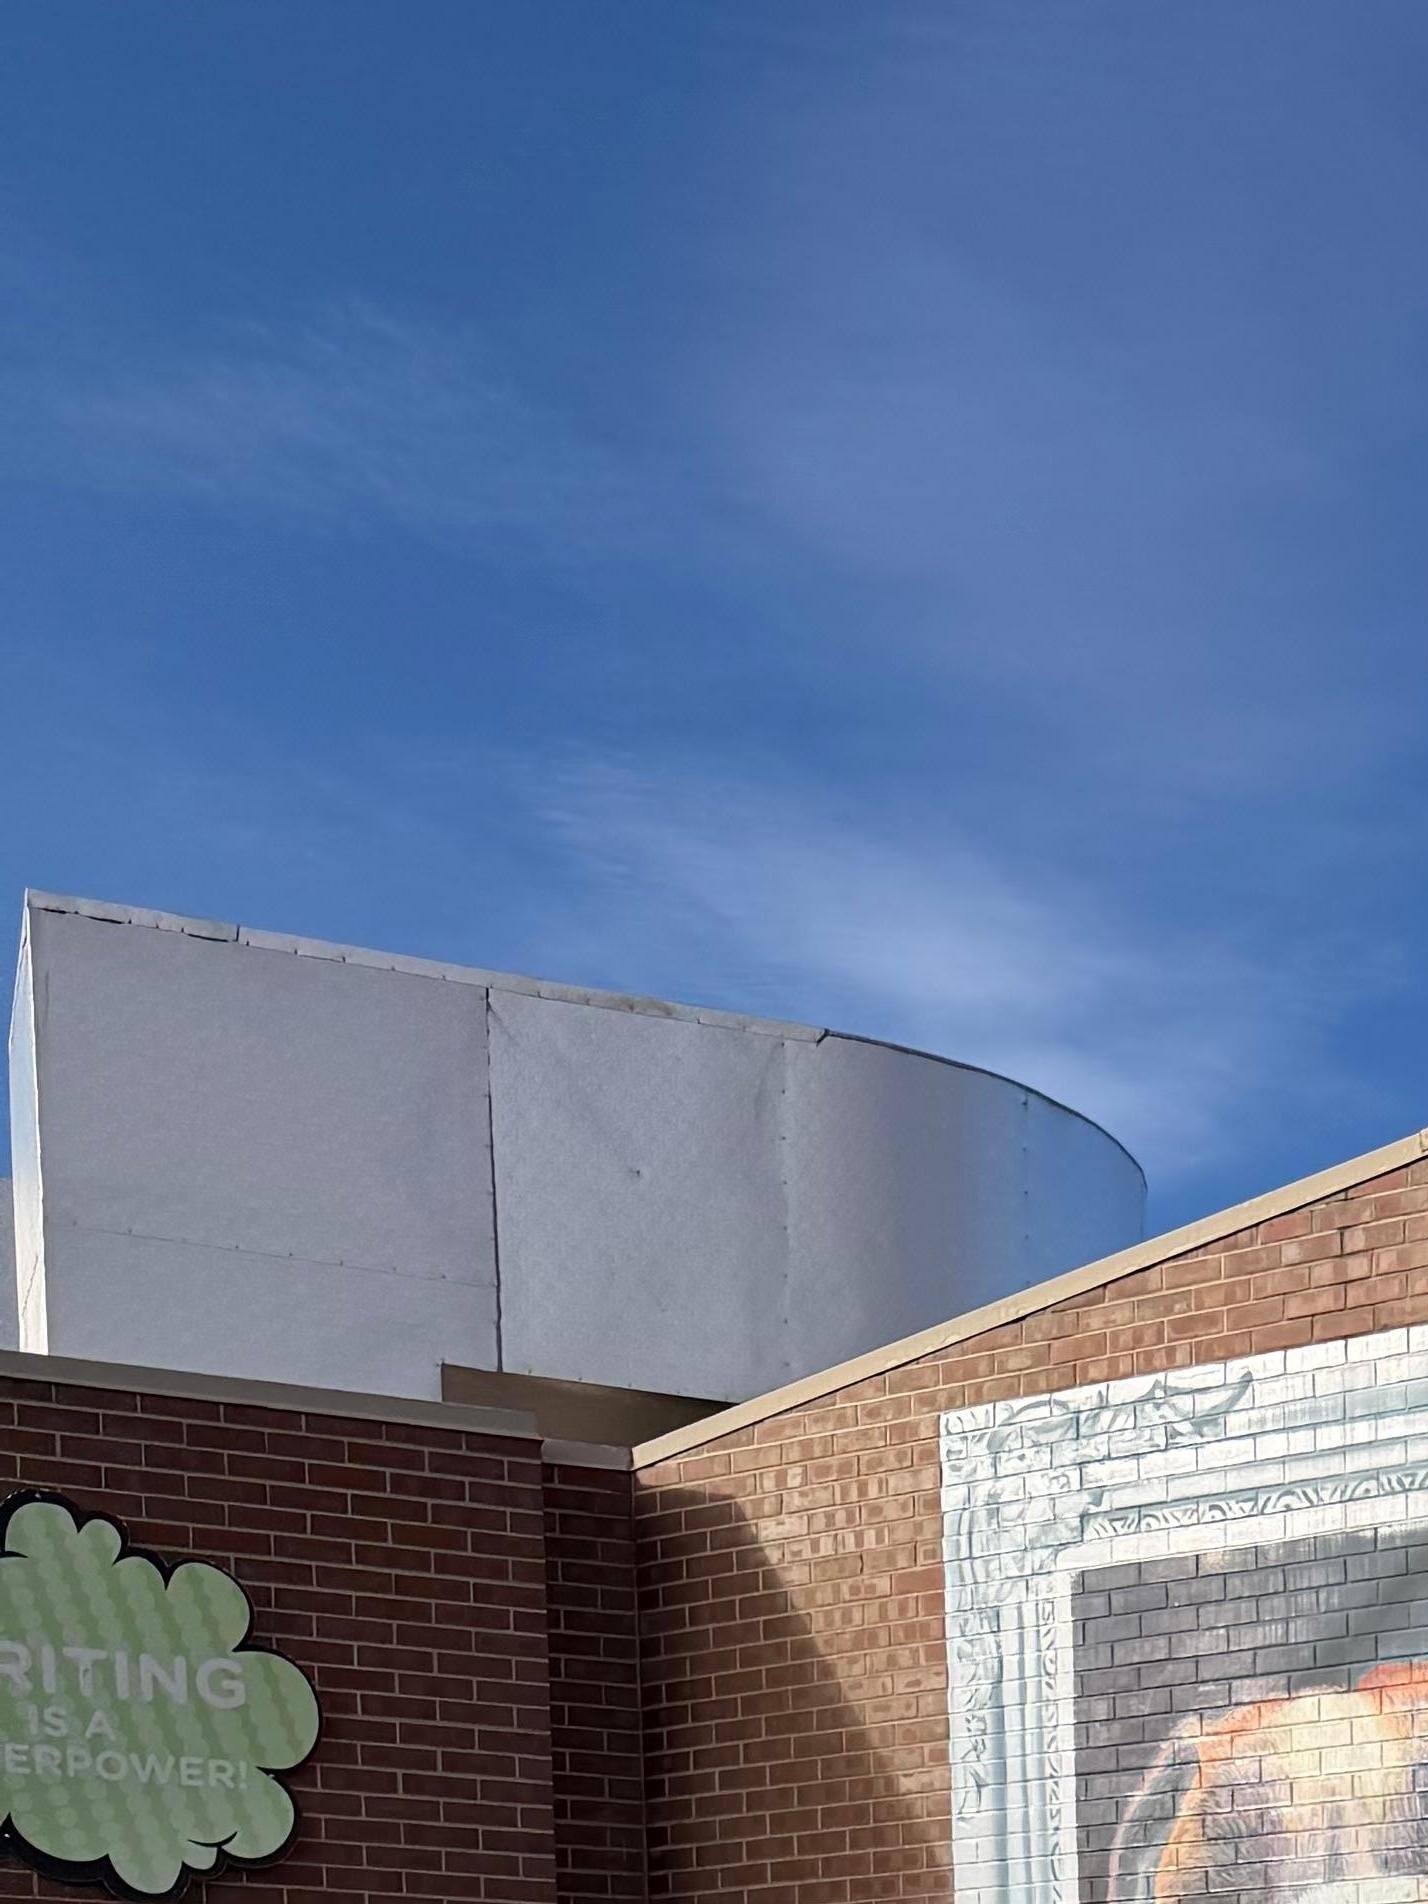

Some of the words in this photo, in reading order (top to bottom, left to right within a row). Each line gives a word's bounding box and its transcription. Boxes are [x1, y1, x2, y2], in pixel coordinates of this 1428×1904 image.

[28, 1703, 69, 1738] IS
[85, 1710, 117, 1742] A
[0, 1742, 249, 1789] ERPOWER!
